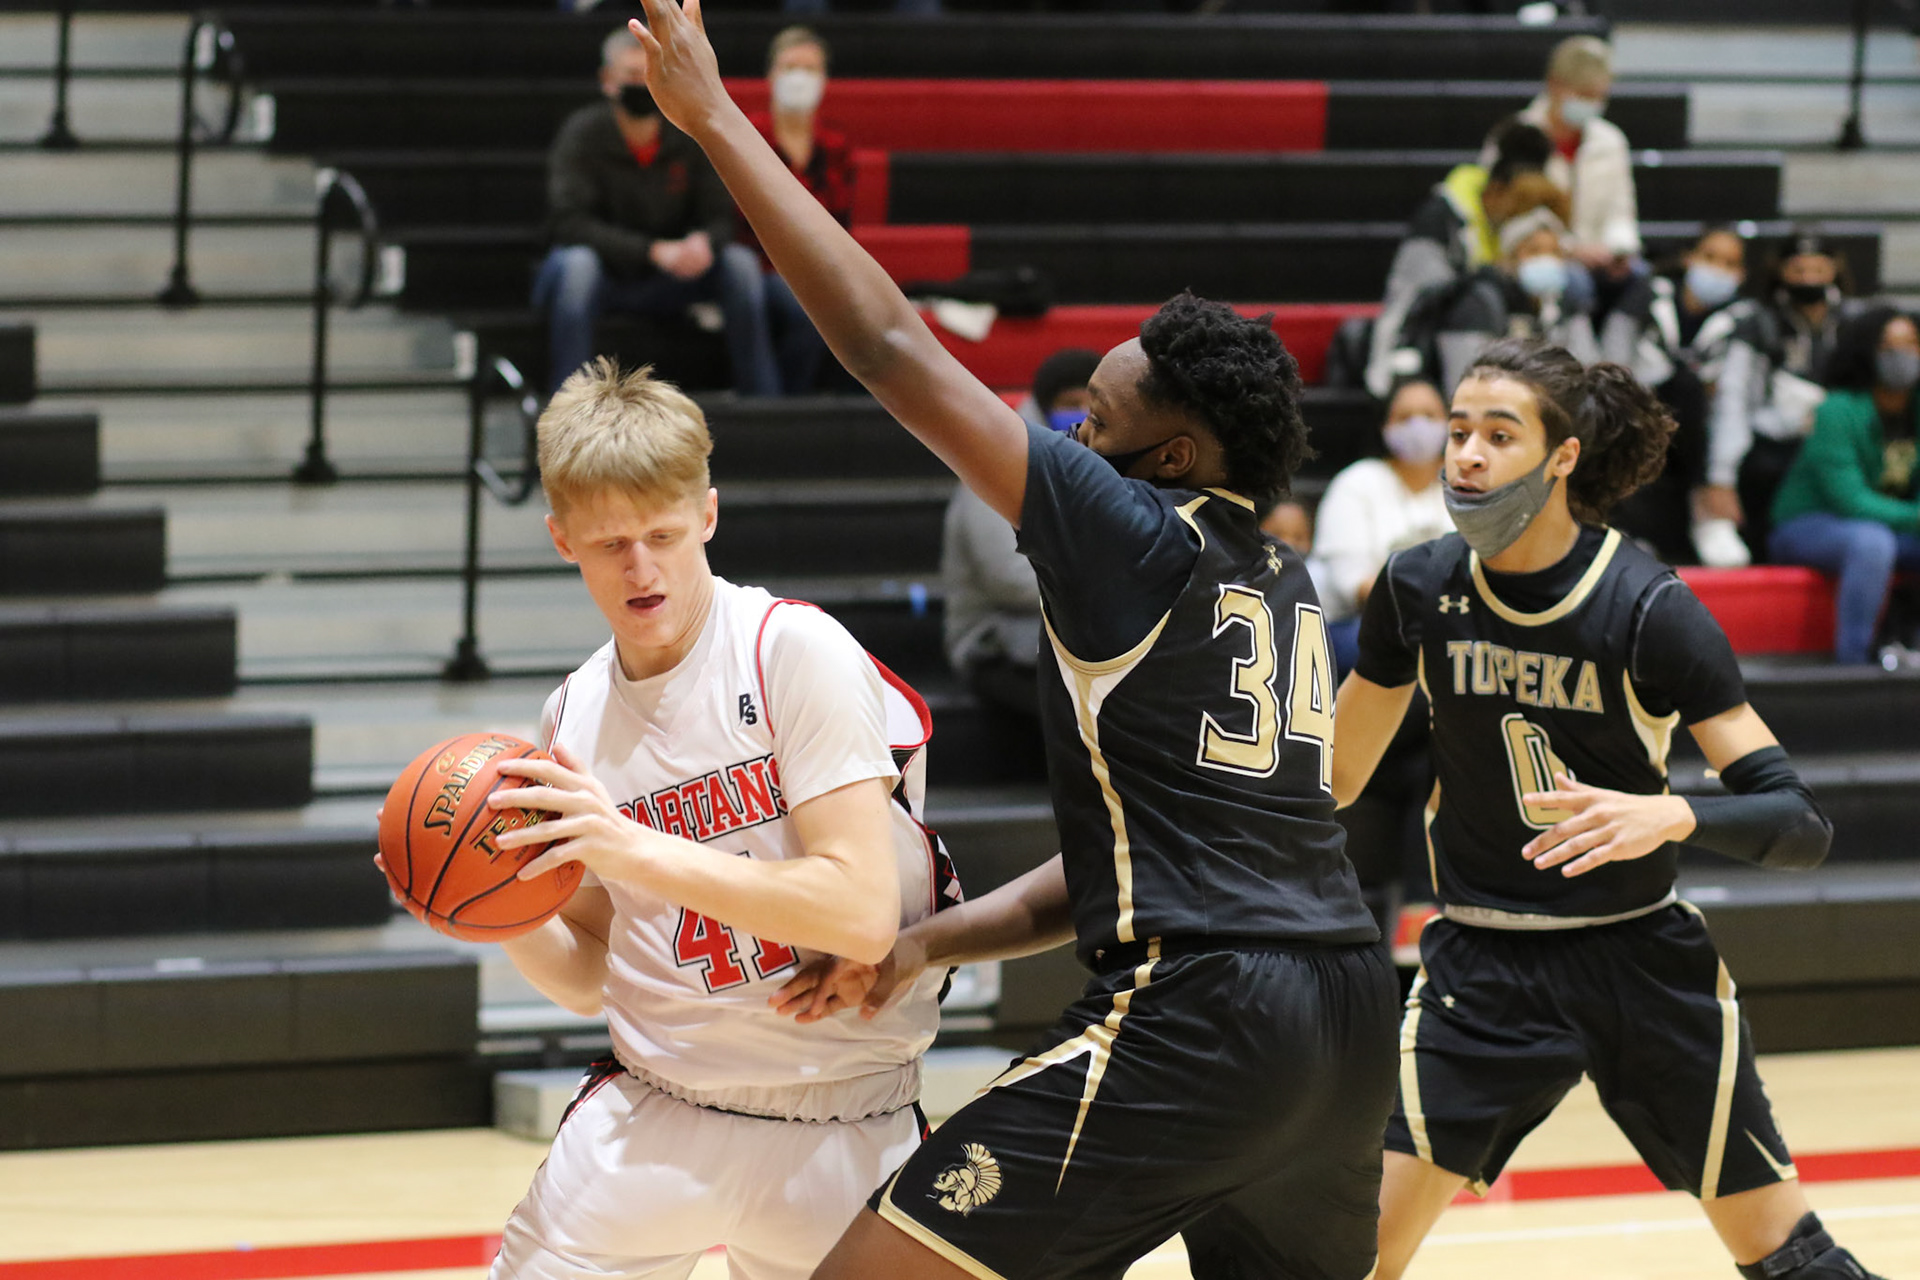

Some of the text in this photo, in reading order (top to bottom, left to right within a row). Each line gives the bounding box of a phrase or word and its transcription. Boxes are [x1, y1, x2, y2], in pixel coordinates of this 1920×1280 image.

[1196, 583, 1336, 795] 34
[1447, 641, 1604, 714] TOPEKA
[615, 752, 789, 843] ARTAN
[1501, 712, 1577, 830] 0
